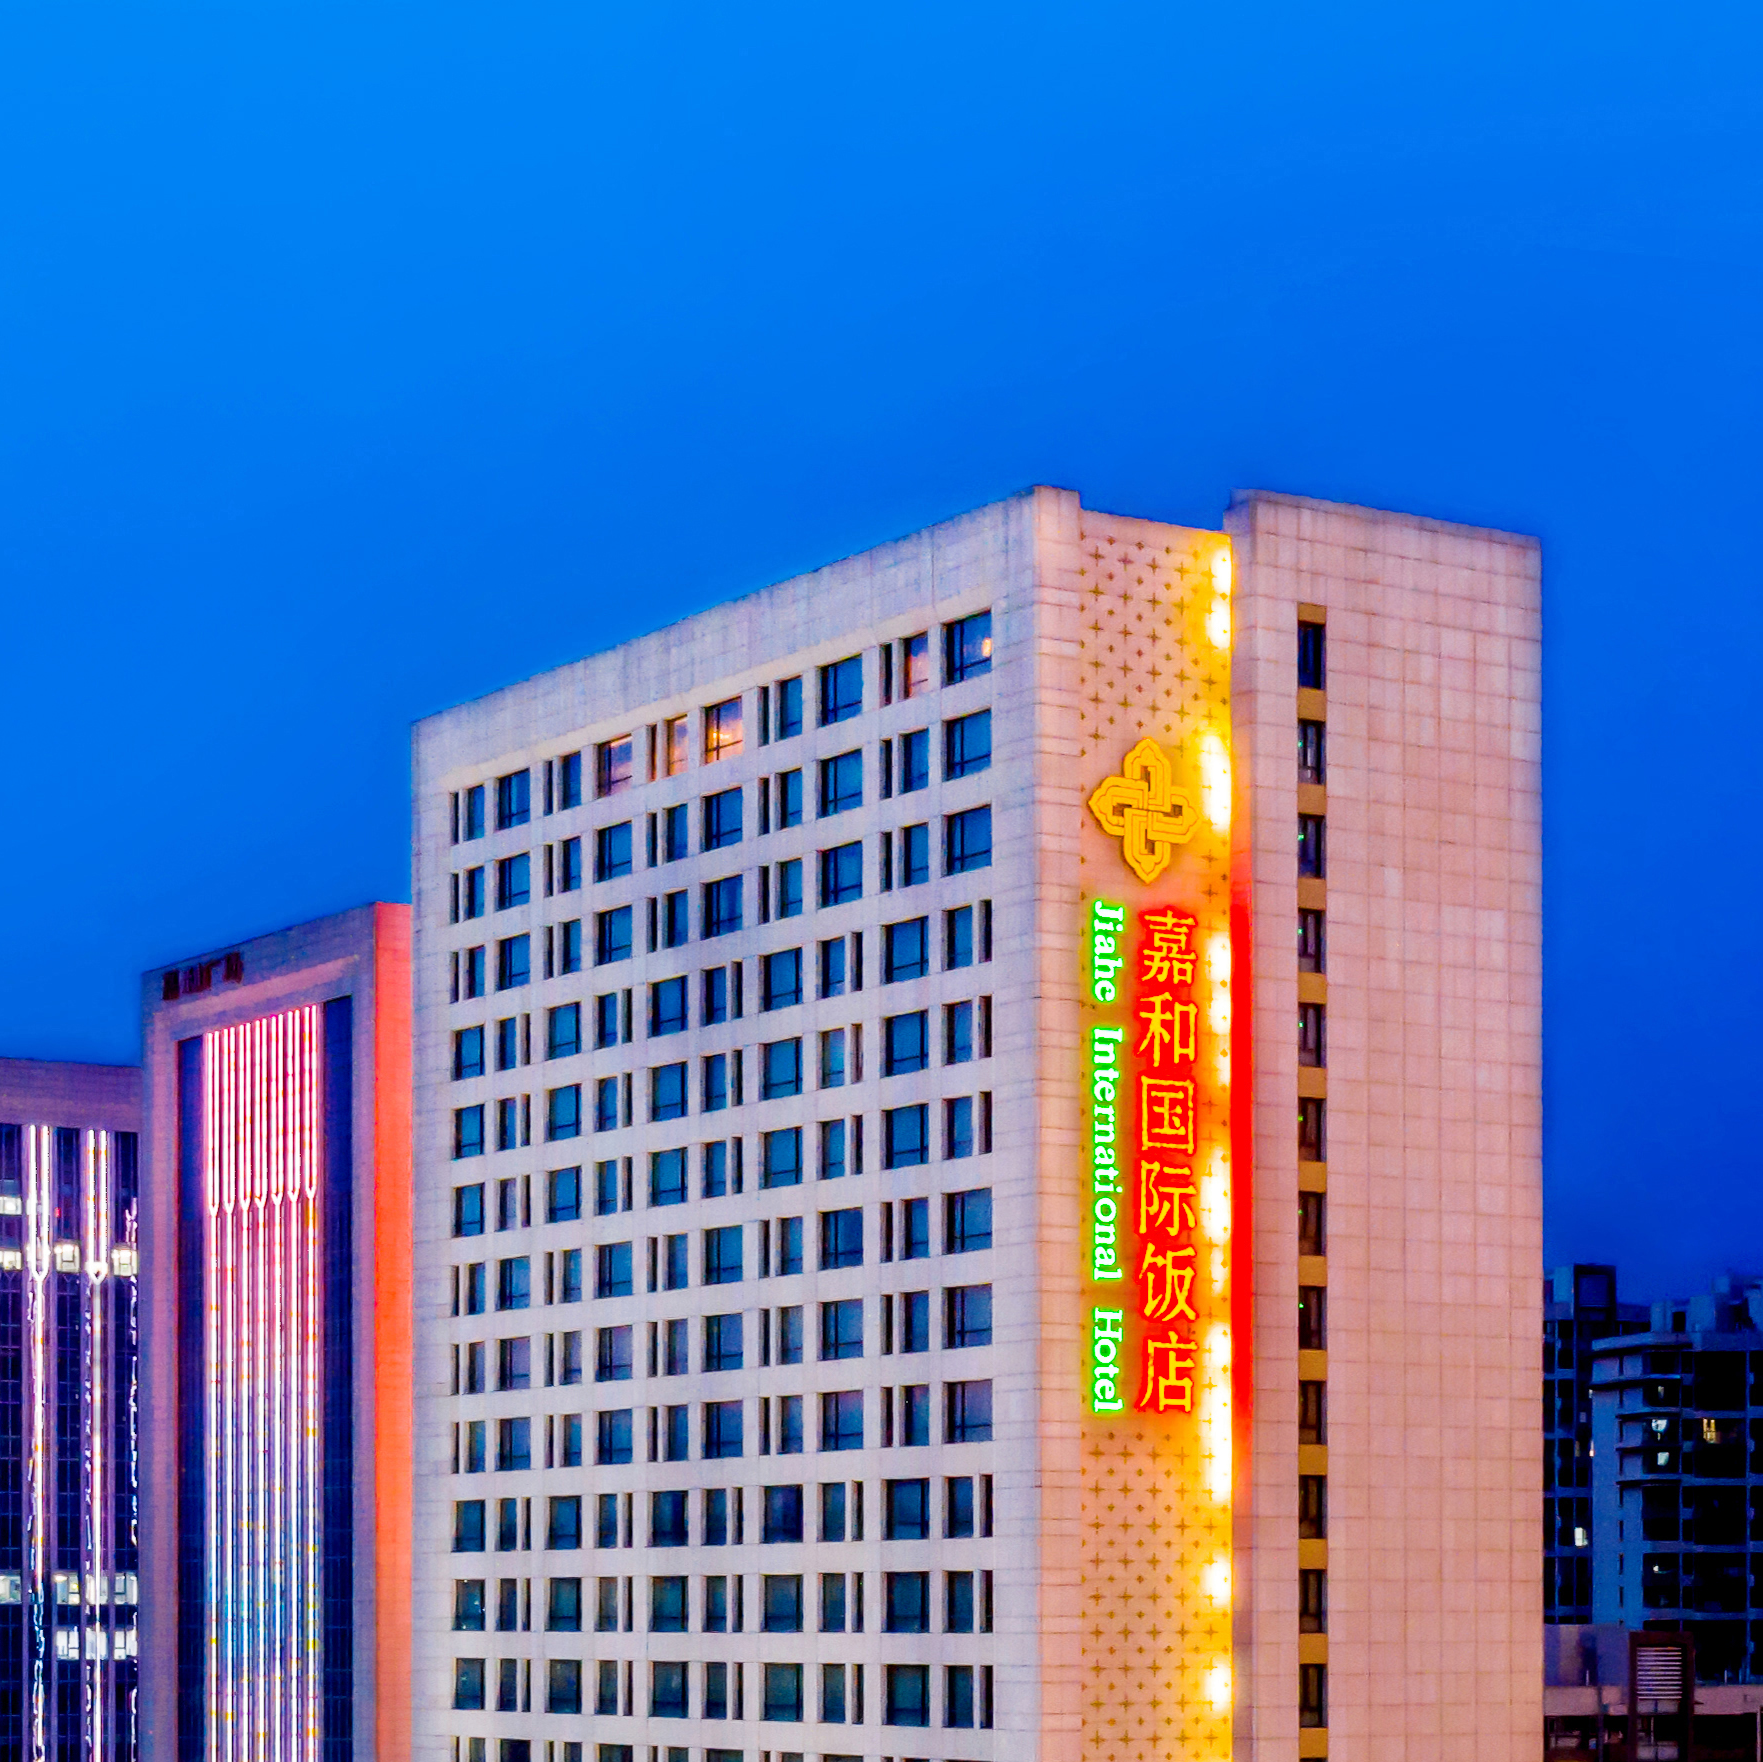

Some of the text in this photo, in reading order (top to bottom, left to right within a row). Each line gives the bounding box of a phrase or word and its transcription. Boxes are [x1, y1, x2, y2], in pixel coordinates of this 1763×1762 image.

[1092, 900, 1124, 1413] Jiahe International Hotel
[1139, 909, 1196, 1412] 嘉和国际饭店
